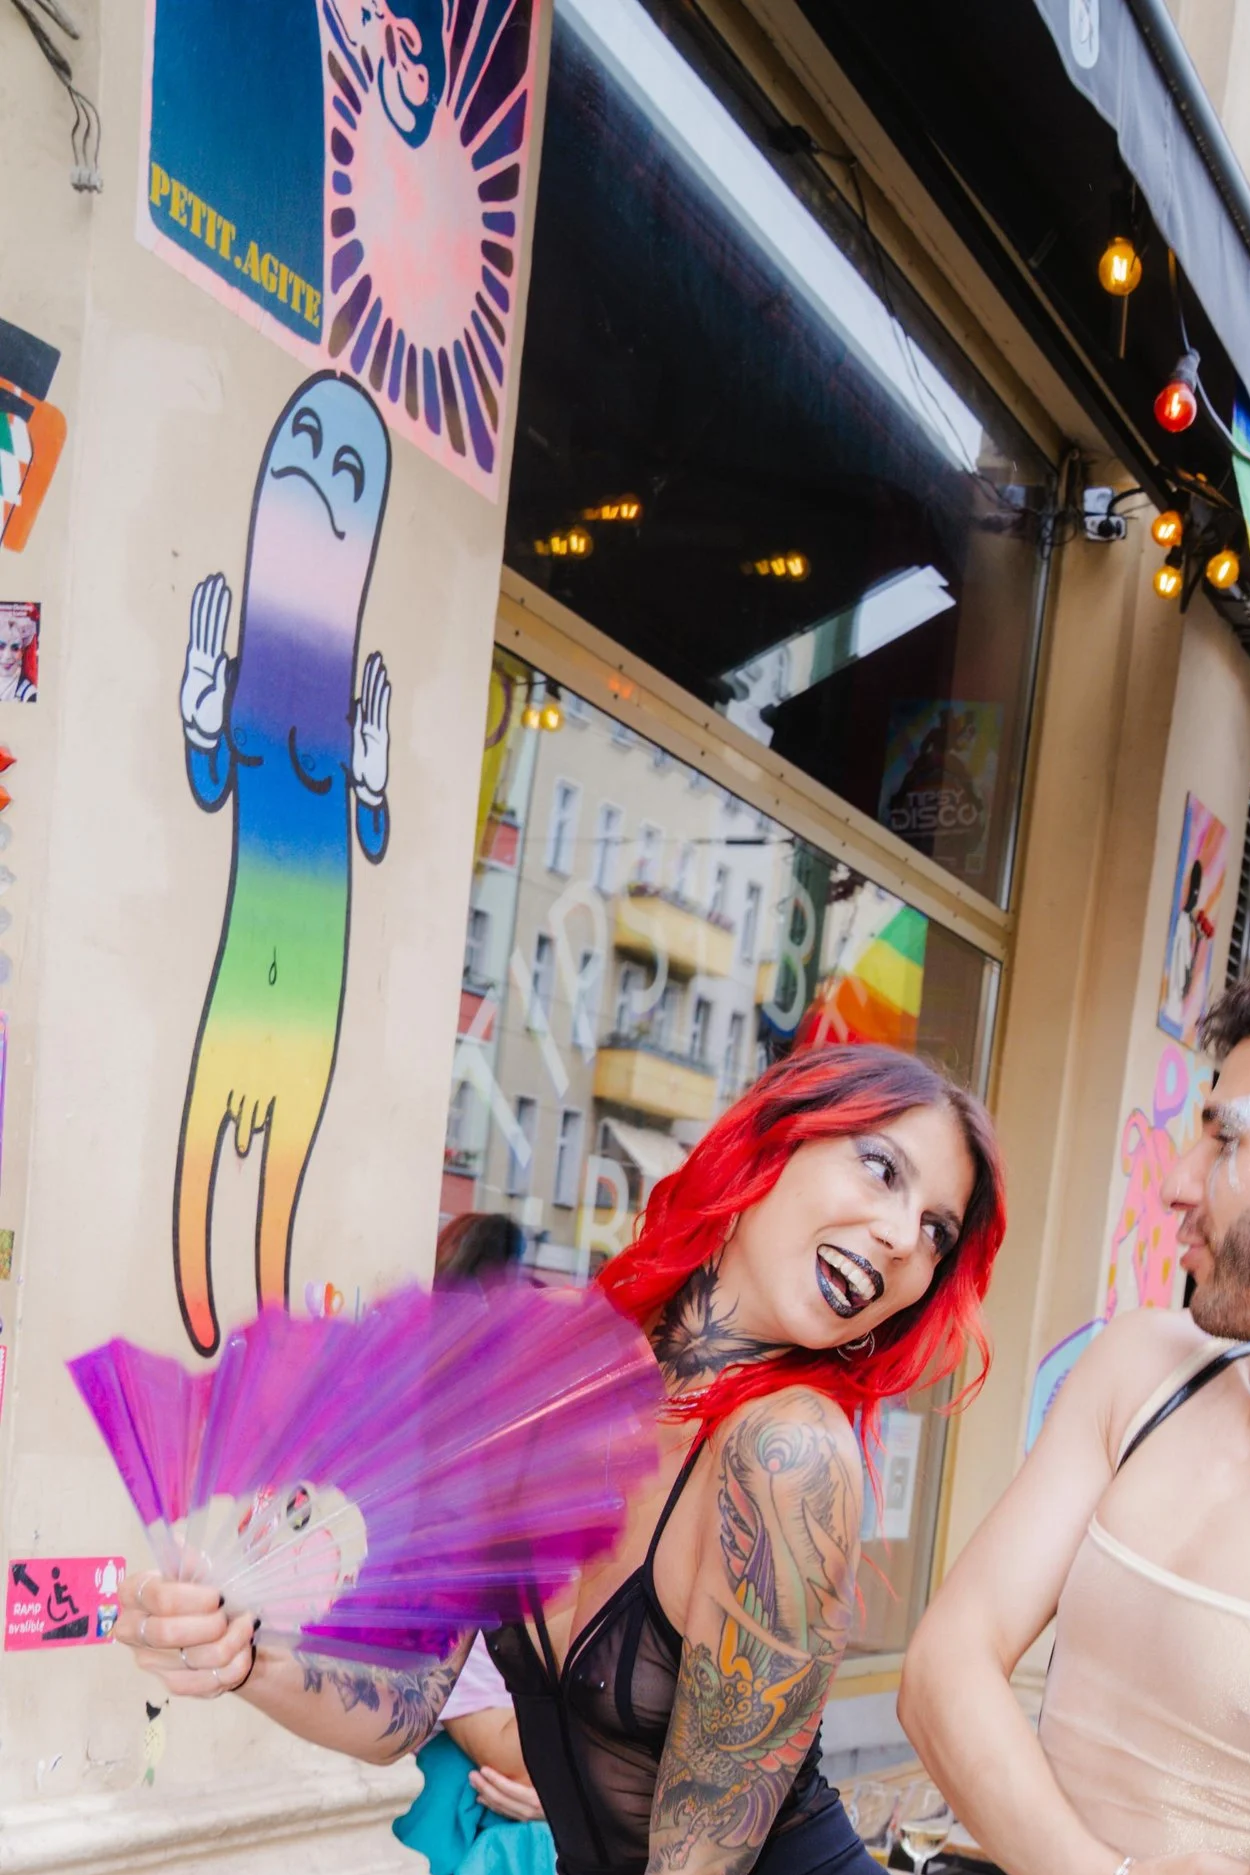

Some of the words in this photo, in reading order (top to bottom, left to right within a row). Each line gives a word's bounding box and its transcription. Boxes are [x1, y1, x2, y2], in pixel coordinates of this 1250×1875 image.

[149, 161, 321, 328] PETIT.AGITE
[906, 788, 966, 807] TIPSY
[891, 803, 979, 832] DISCO
[13, 1602, 42, 1616] RAMP
